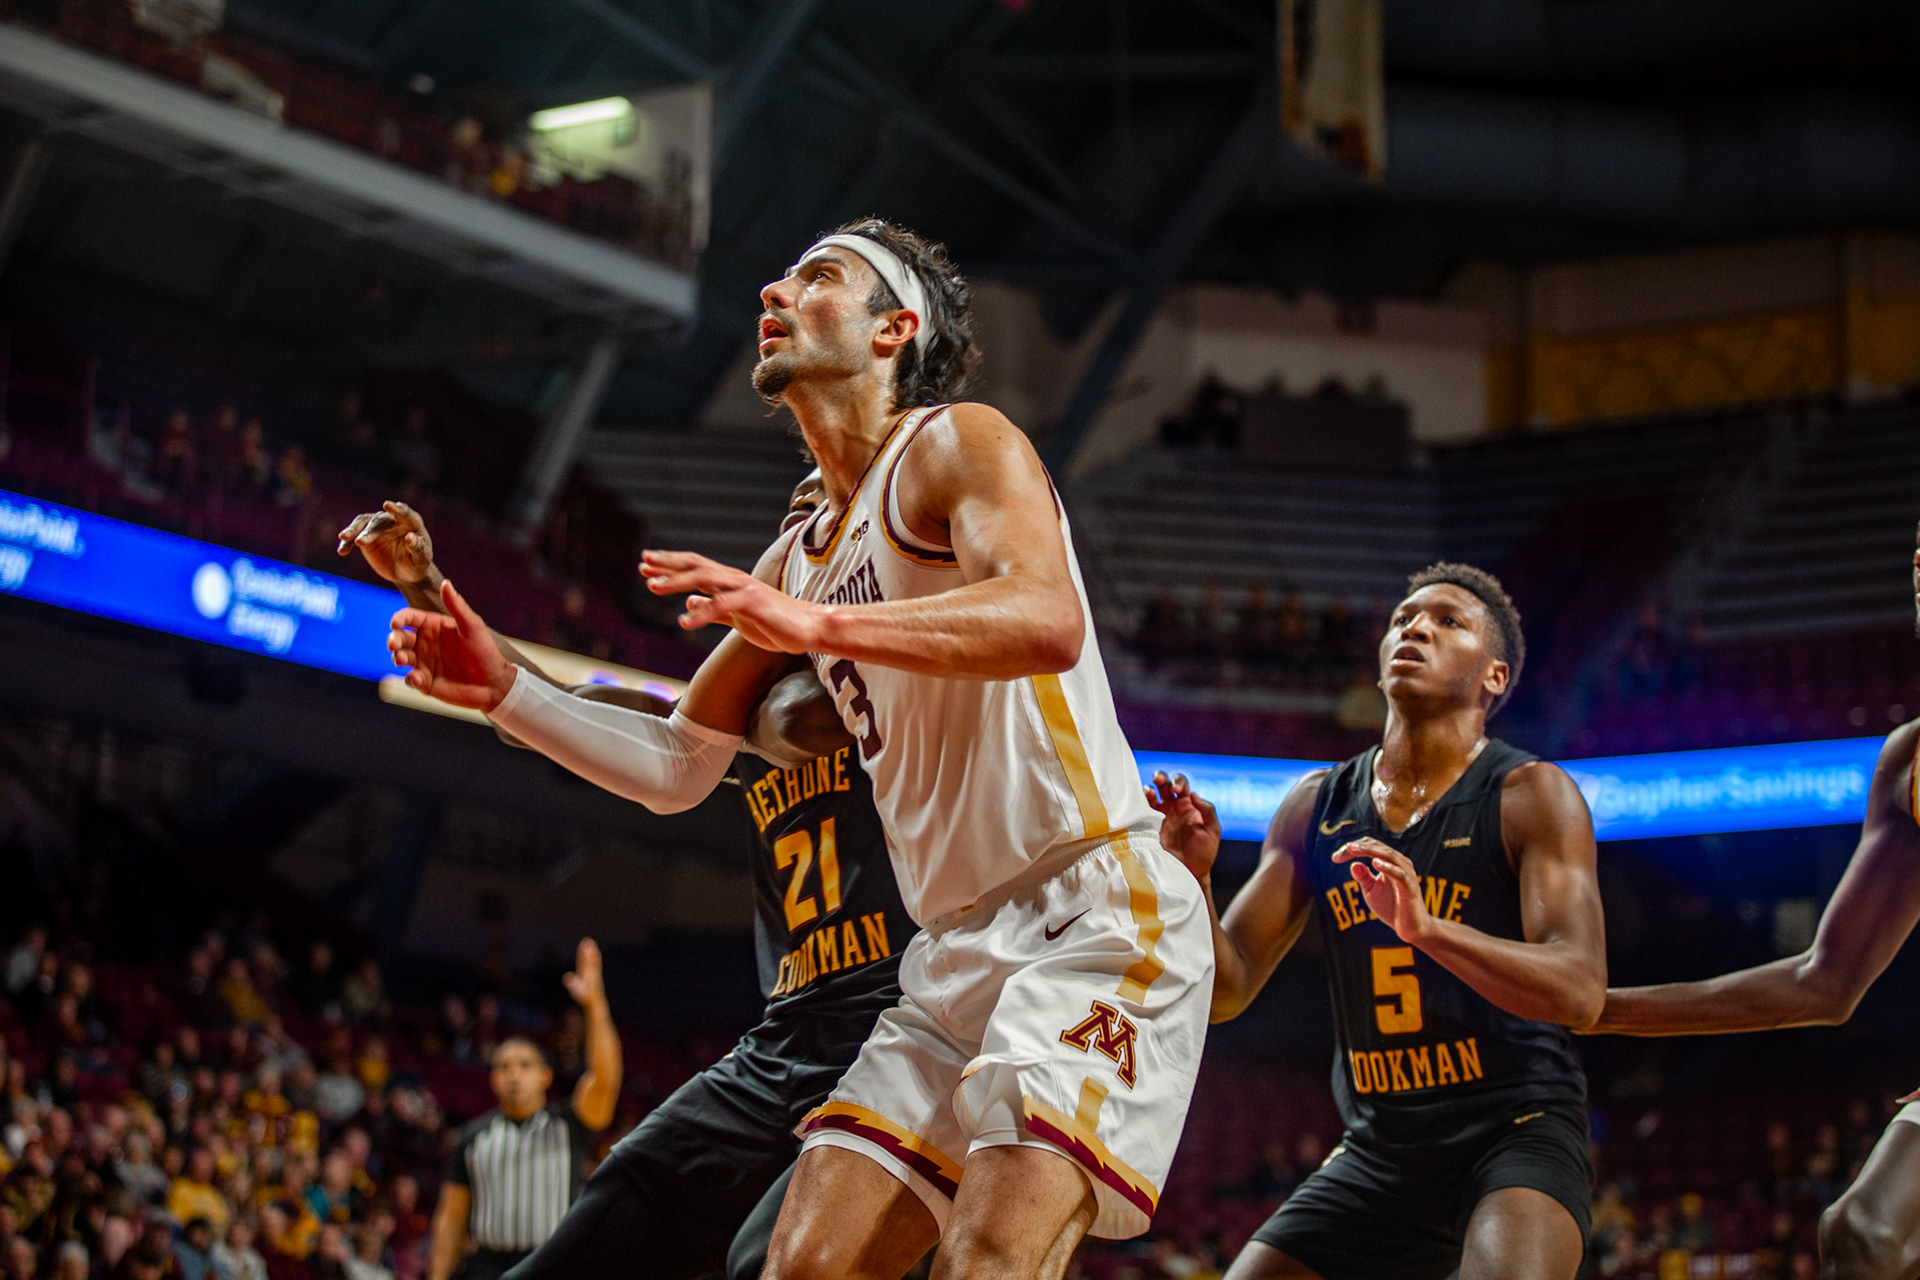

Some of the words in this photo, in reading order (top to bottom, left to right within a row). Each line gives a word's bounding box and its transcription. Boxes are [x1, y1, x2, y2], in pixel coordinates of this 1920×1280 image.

[829, 658, 883, 762] 3
[774, 816, 842, 935] 21
[1325, 874, 1472, 932] BENE
[769, 911, 892, 998] COOKMAN
[1370, 945, 1424, 1036] 5
[1058, 999, 1138, 1090] M
[1349, 1037, 1484, 1095] OOKMAN
